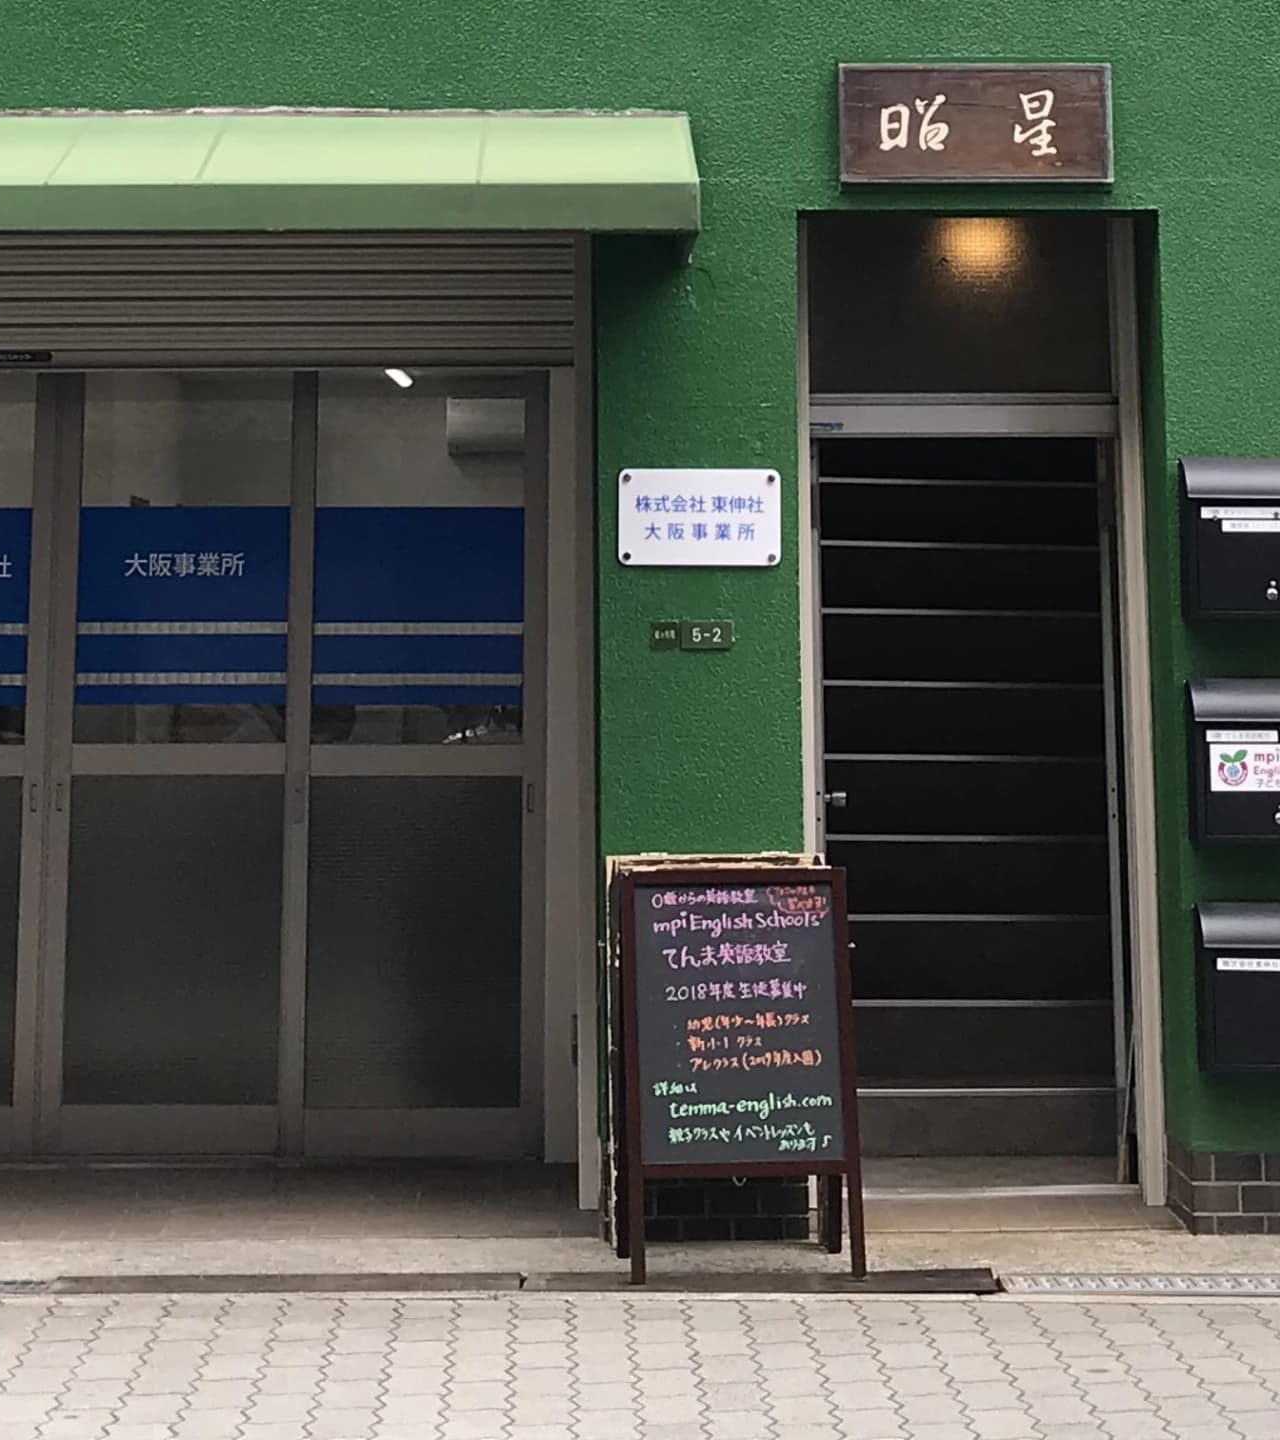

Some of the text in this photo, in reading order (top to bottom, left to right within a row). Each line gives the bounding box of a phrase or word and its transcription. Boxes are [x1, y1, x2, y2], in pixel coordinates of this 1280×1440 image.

[634, 494, 765, 514] 株式会社 東伸社
[644, 522, 756, 542] 大阪事業所
[124, 551, 246, 578] 大阪事業所
[691, 627, 722, 643] 5-2
[1254, 747, 1280, 766] mpi
[653, 911, 687, 936] mpi
[690, 913, 753, 938] English
[662, 940, 792, 969] てんま英語教室
[665, 981, 735, 1001] 2018年度
[670, 1092, 832, 1119] temma-english.com
